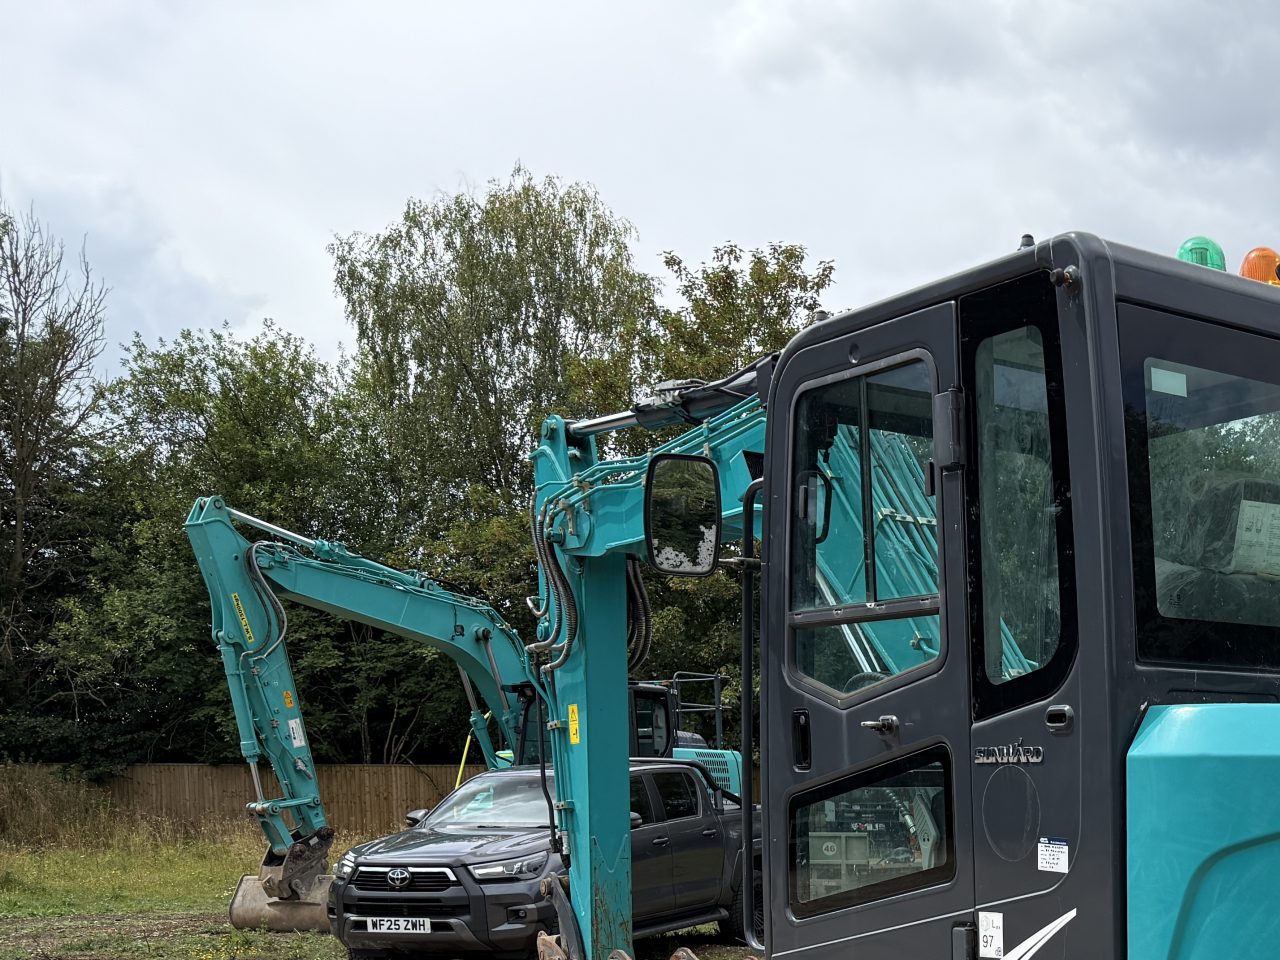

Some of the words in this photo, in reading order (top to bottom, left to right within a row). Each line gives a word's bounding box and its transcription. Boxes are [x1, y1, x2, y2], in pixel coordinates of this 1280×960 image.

[975, 740, 1044, 763] SUNWARD
[371, 918, 401, 931] WF25
[403, 919, 426, 931] ZWH
[982, 934, 994, 948] 97
